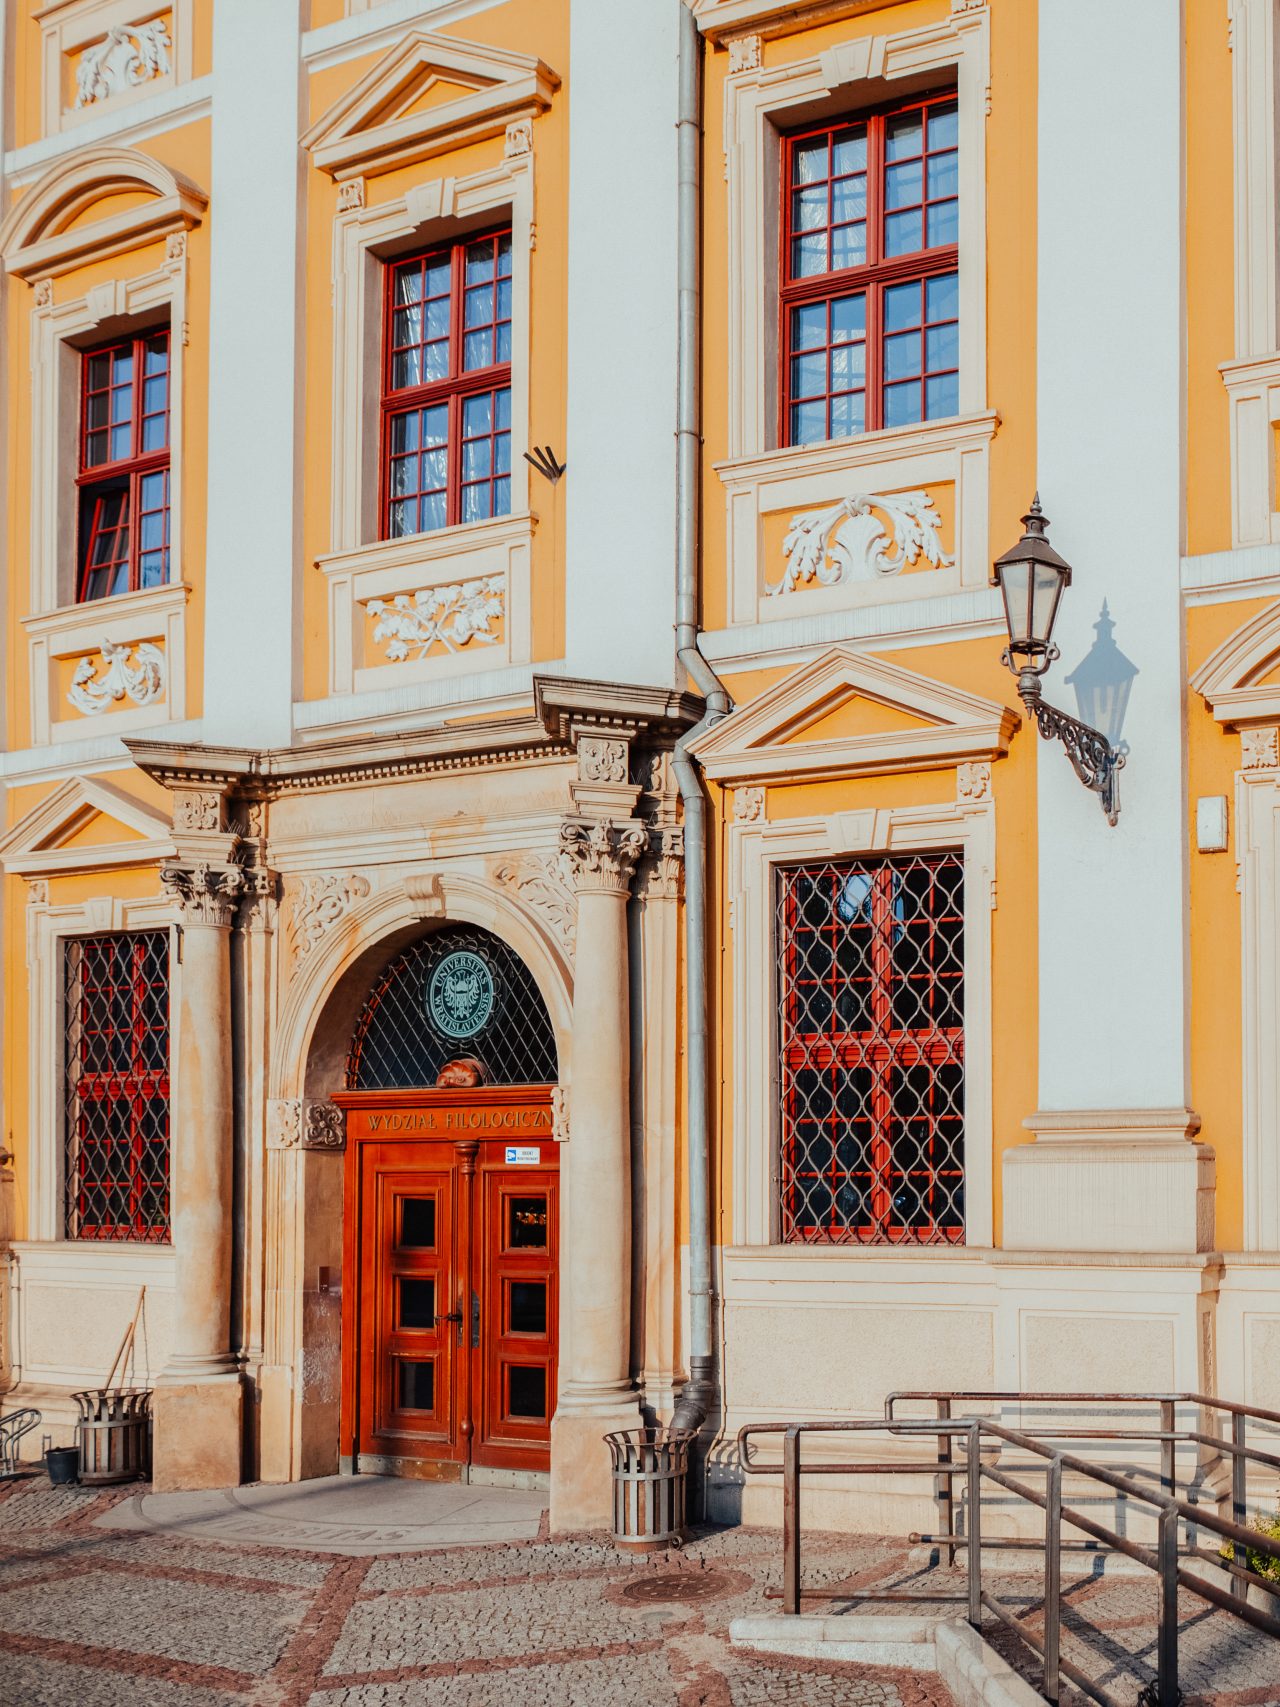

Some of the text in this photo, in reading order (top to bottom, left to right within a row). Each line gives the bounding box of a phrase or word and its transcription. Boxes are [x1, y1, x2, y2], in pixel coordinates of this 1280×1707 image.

[435, 957, 487, 987] UNIVERSITAS
[434, 992, 490, 1031] WRATISLAVIENSIS
[368, 1110, 553, 1131] WYDZIAŁ FILOLOGICZN
